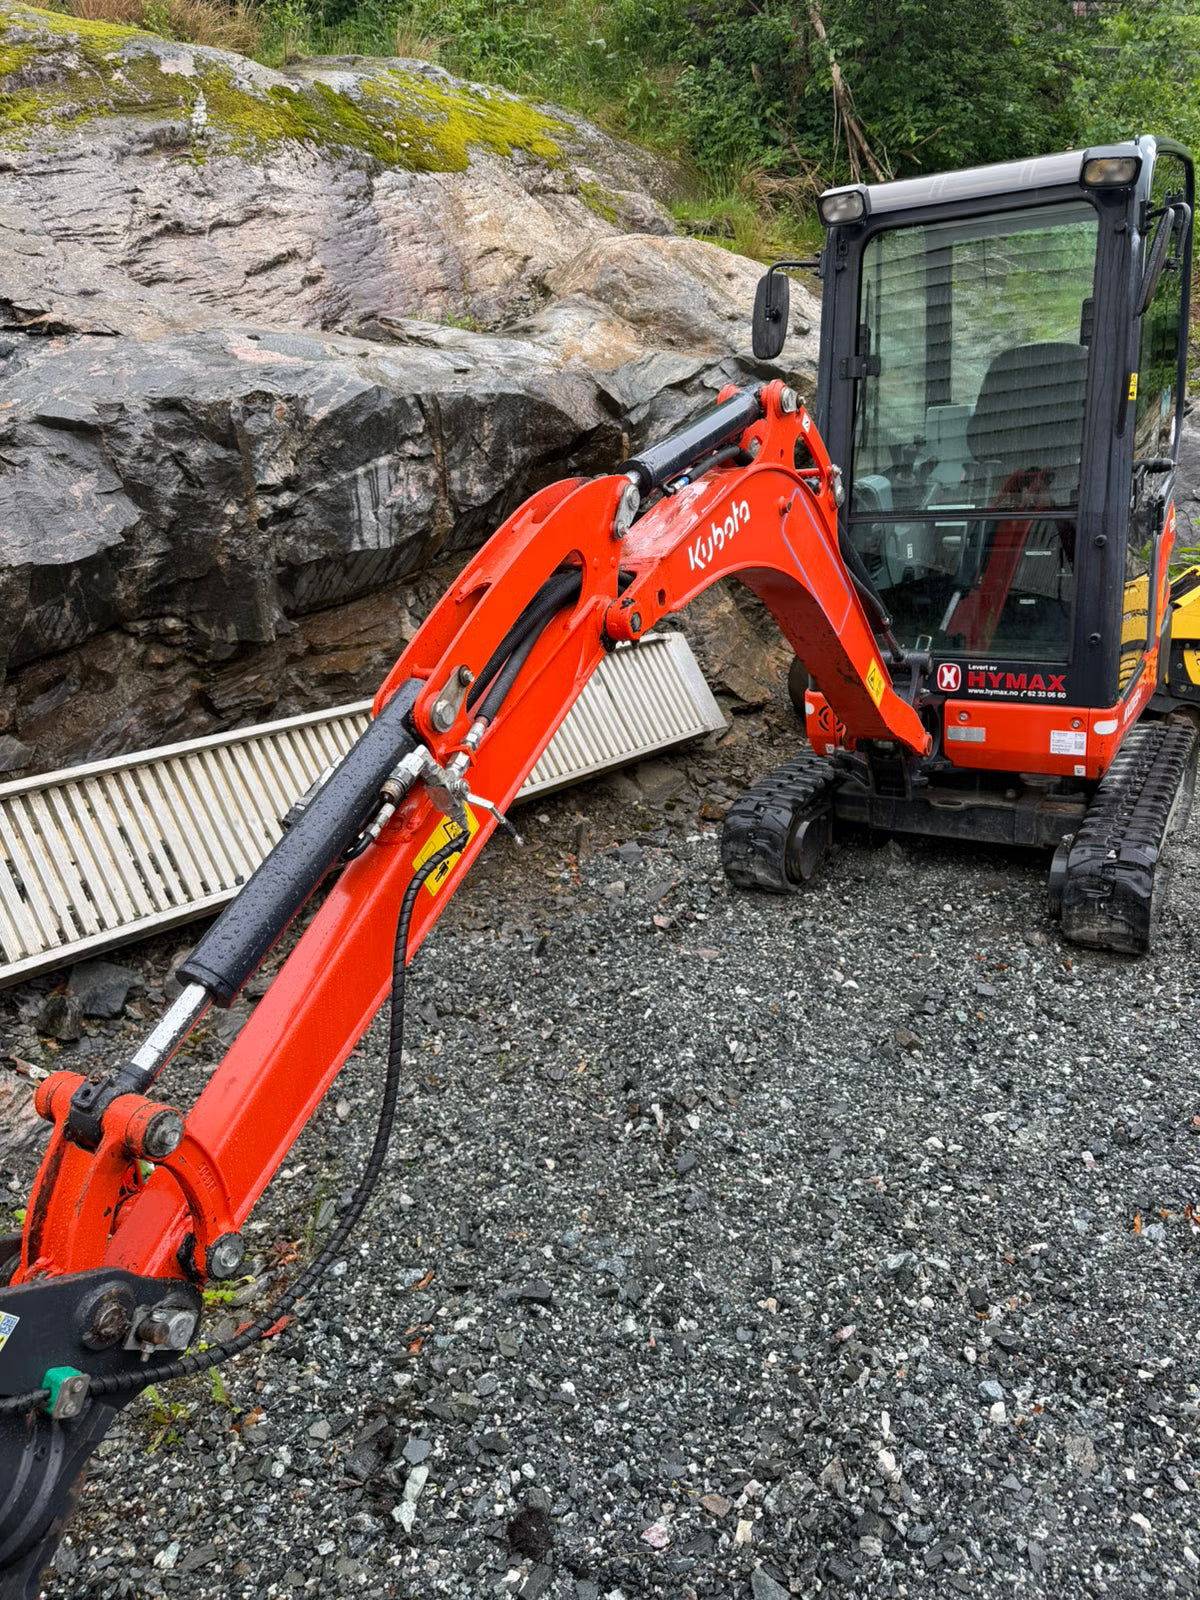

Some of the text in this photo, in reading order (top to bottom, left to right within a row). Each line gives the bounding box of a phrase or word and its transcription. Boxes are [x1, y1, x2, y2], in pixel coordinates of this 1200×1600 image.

[688, 500, 750, 571] Kubota
[967, 671, 1067, 692] HYMAX
[968, 688, 1019, 697] www.hymax.no
